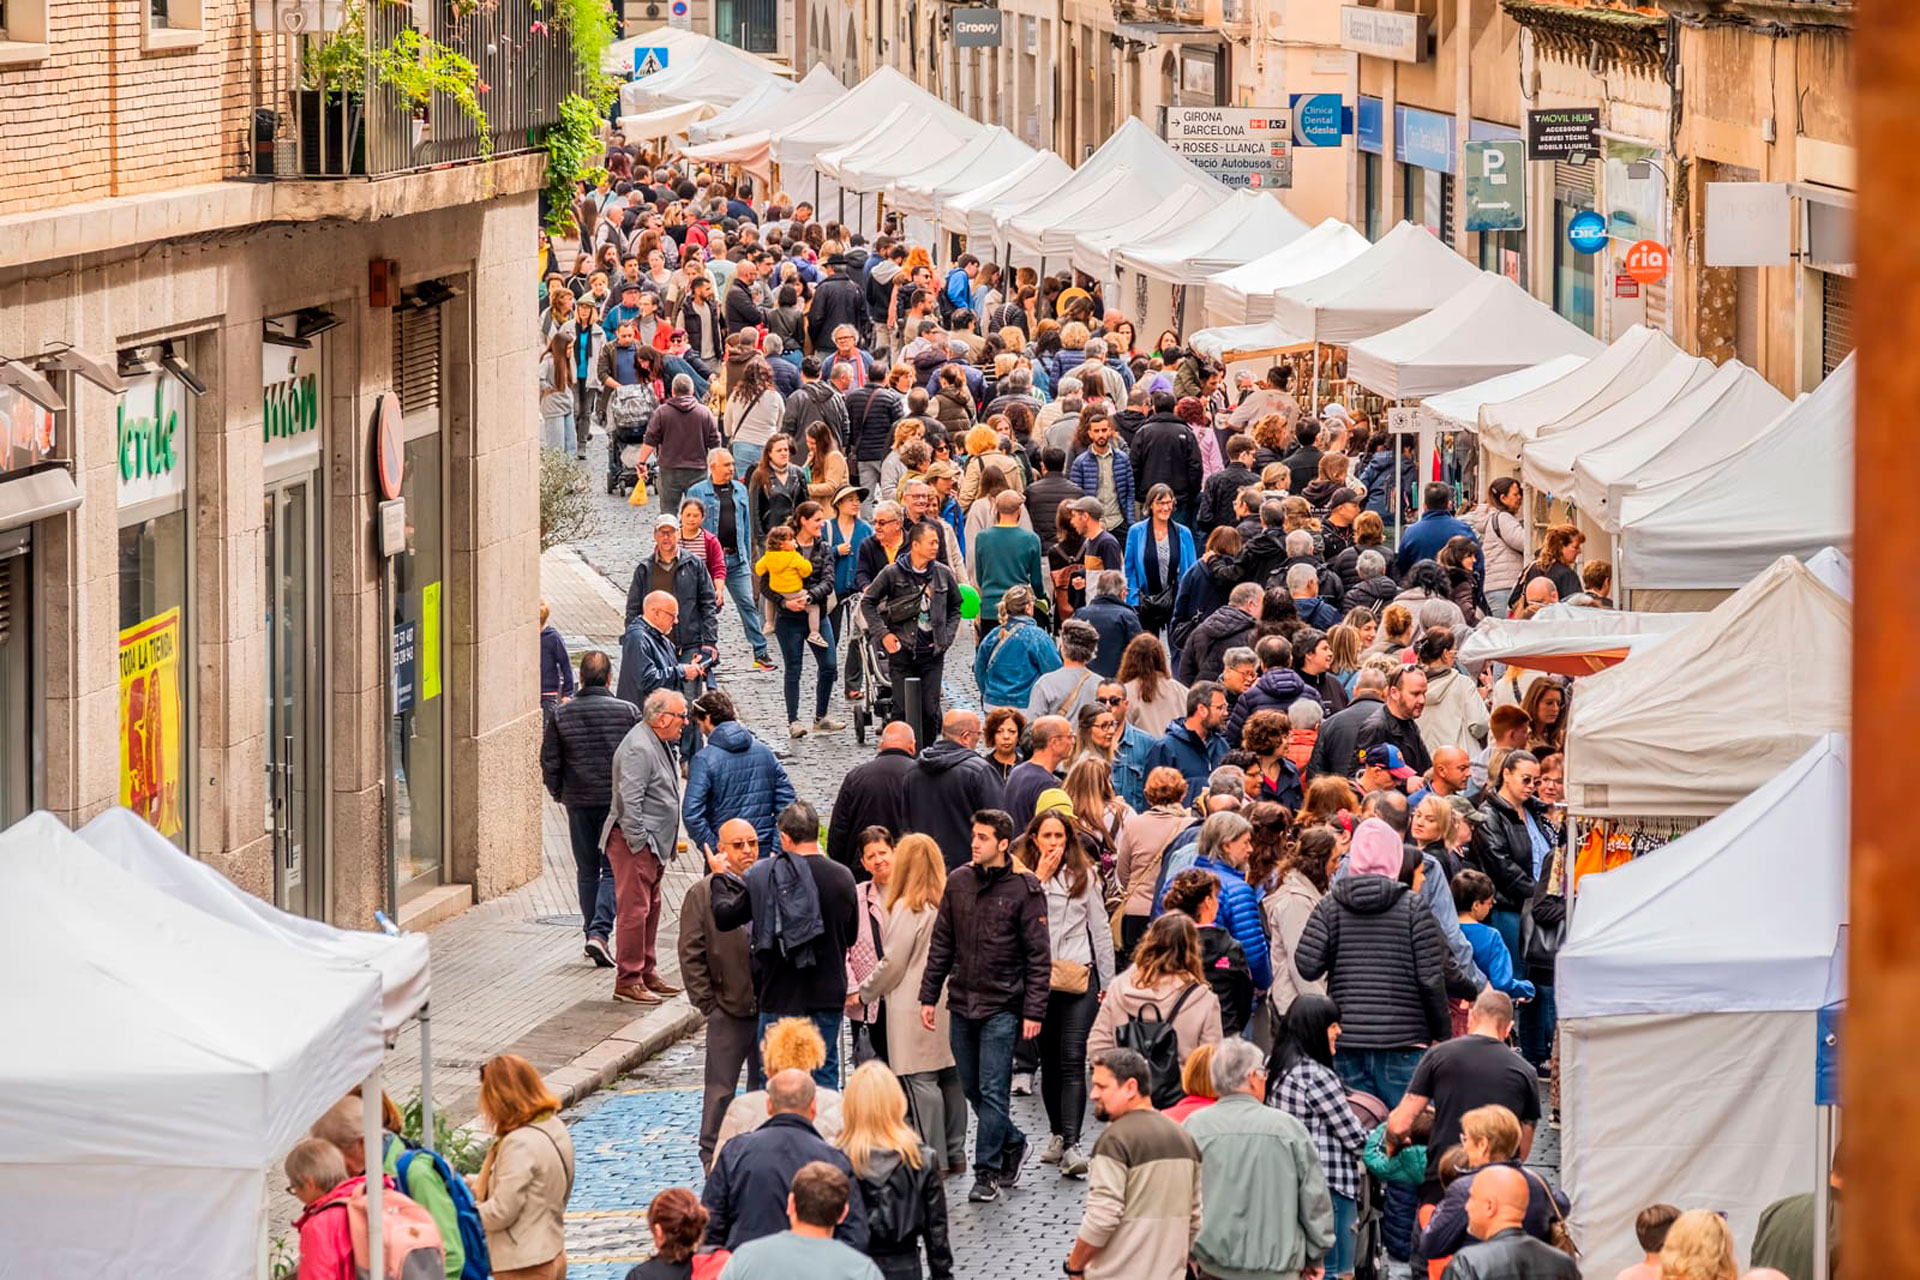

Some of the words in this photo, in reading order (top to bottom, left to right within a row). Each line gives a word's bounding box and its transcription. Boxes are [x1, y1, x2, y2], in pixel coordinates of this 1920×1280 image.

[956, 22, 999, 34] Groovy
[1183, 111, 1223, 122] GIRONA
[1304, 115, 1333, 125] Dental
[1270, 120, 1285, 128] A-7
[1183, 125, 1245, 136] BARCELONA
[1185, 156, 1218, 168] tació
[1221, 158, 1272, 169] Autobusos
[1483, 149, 1505, 177] P
[1222, 174, 1250, 185] Renfe
[1630, 245, 1663, 267] ria
[138, 642, 148, 670] LA
